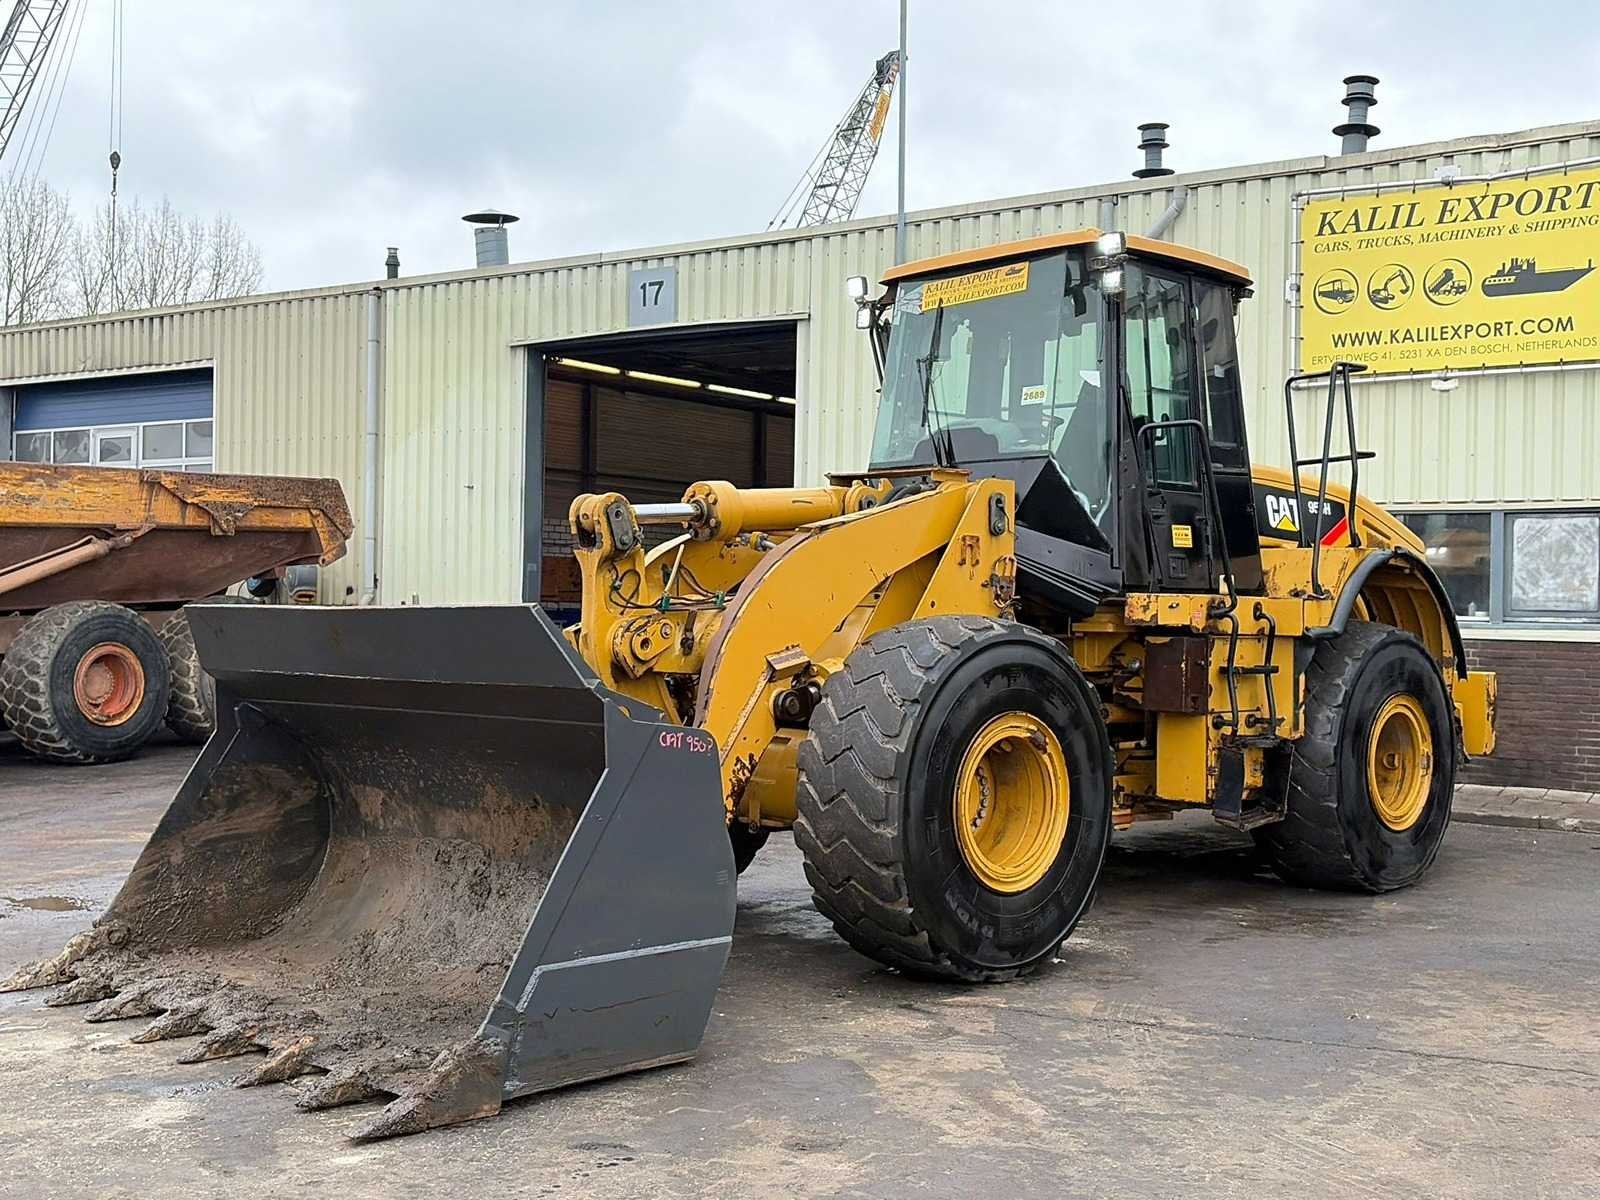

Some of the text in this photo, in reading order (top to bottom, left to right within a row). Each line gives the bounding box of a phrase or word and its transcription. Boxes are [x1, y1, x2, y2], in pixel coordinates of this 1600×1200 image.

[1315, 181, 1600, 237] KALIL EXPORT
[1314, 214, 1600, 254] CARS, TRUCKS, MACHINERY & SHIPPING
[640, 280, 665, 307] 17
[925, 280, 955, 293] KALIL
[958, 270, 1001, 286] EXPORT
[1331, 315, 1575, 348] WWW.KALILEXPORT.COM
[1399, 348, 1422, 360] 5231
[1426, 347, 1442, 358] XA
[1444, 345, 1467, 357] DEN
[1516, 336, 1598, 353] NETHERLANDS
[1265, 494, 1332, 531] CAT 95H
[660, 731, 684, 748] CAT
